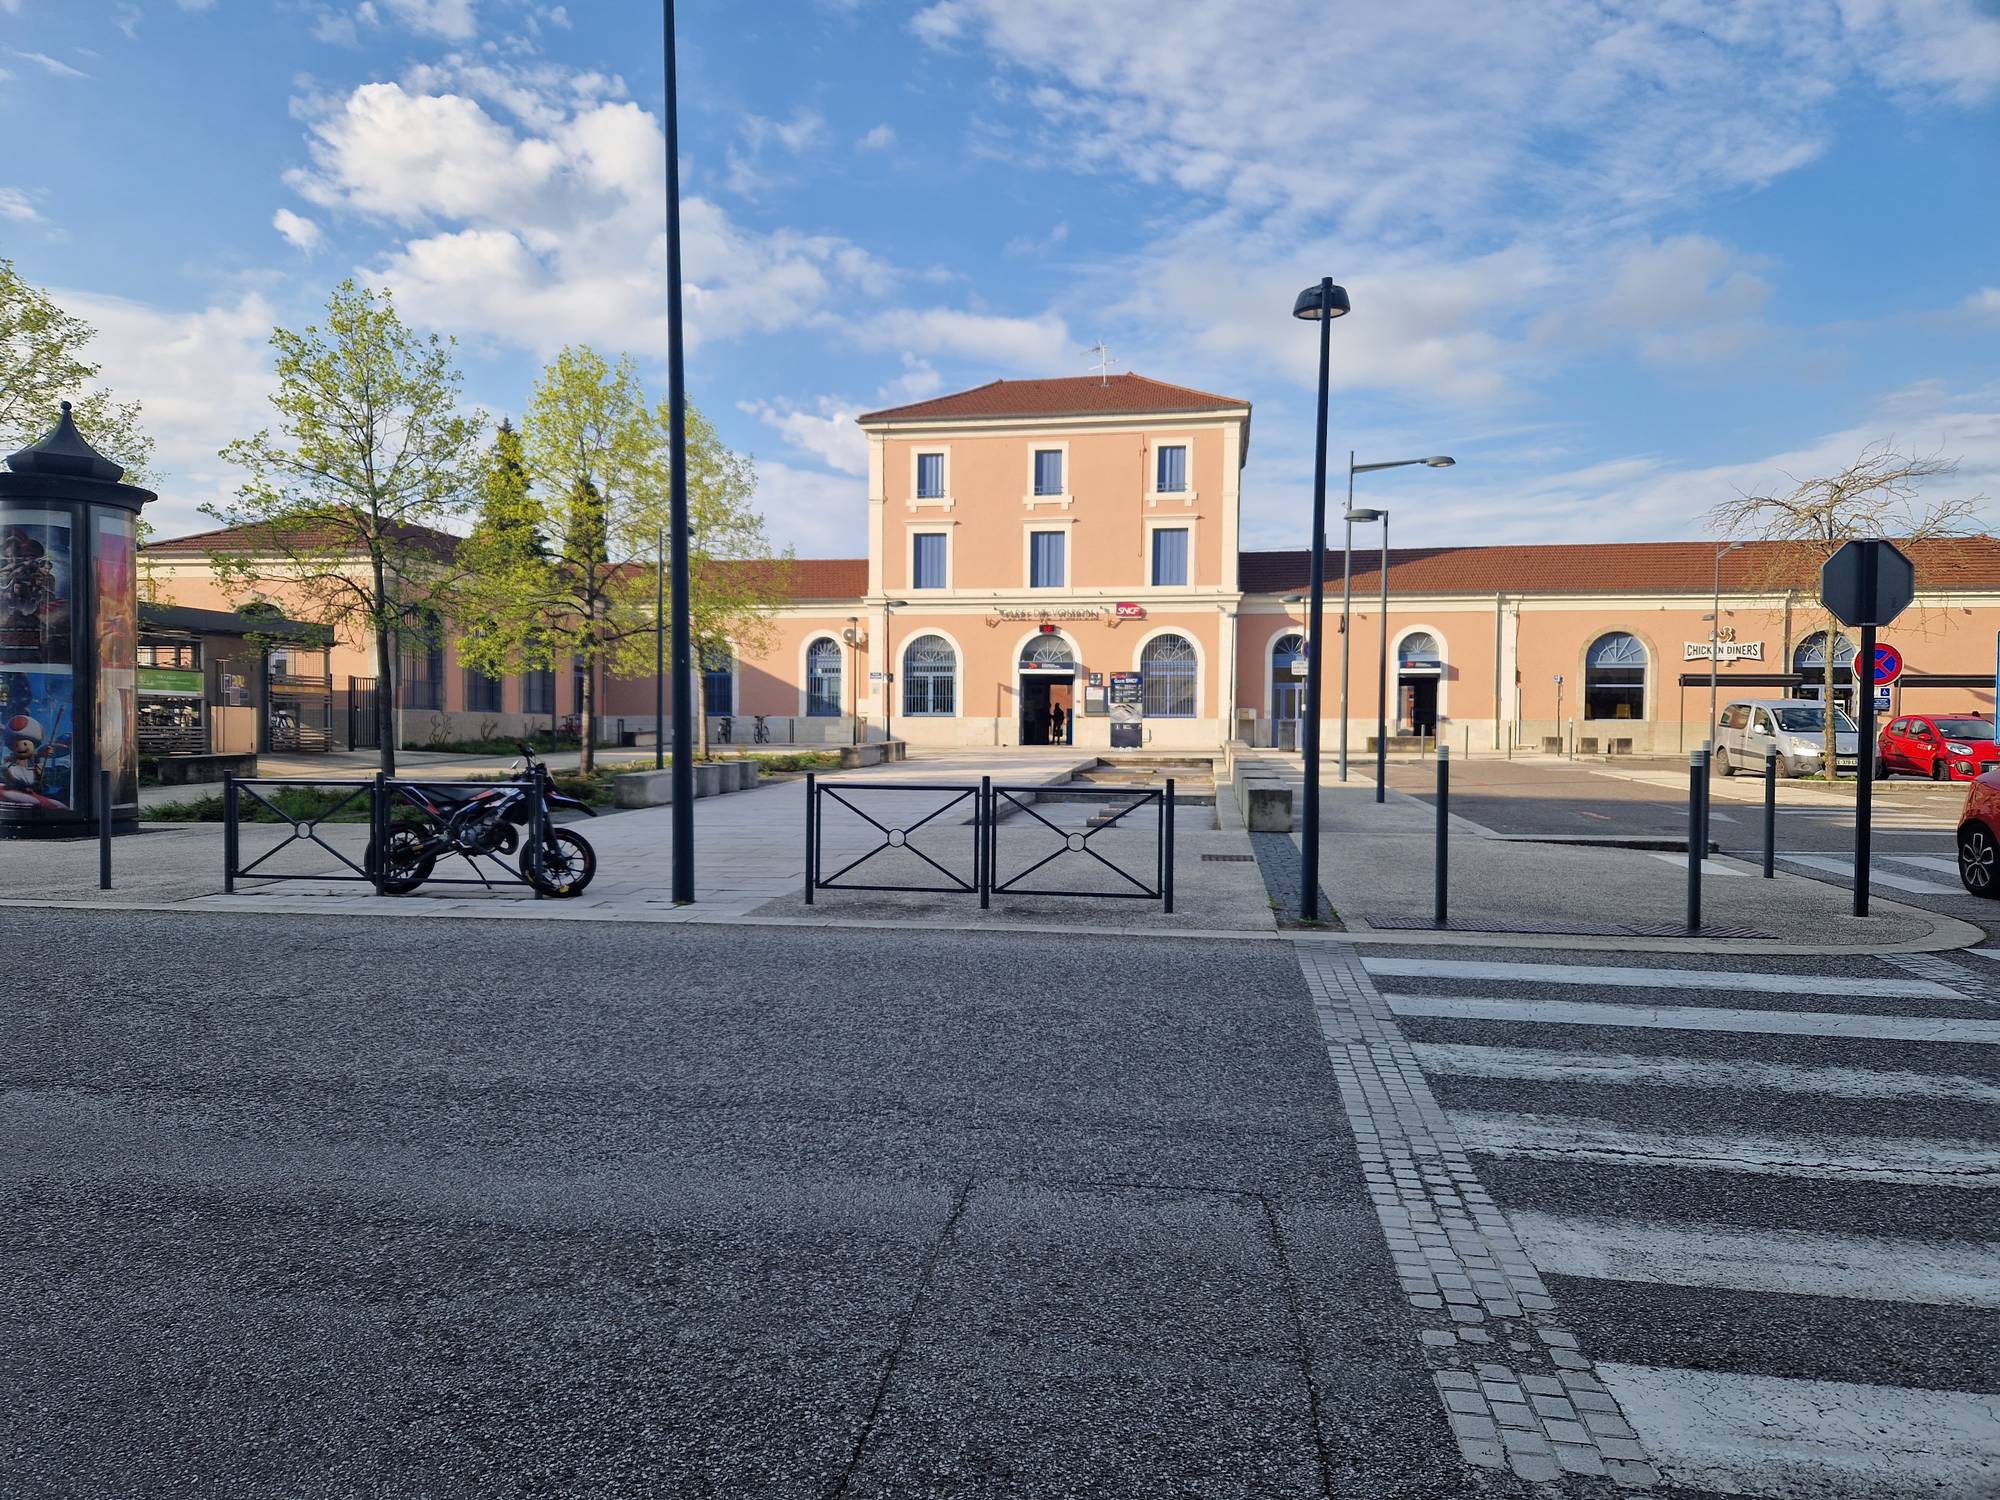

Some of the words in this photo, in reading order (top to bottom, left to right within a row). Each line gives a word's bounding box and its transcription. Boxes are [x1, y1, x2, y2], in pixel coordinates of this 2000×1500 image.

[1117, 607, 1140, 615] SNCF
[1687, 645, 1724, 656] CHICKN
[1727, 644, 1758, 656] DINERS
